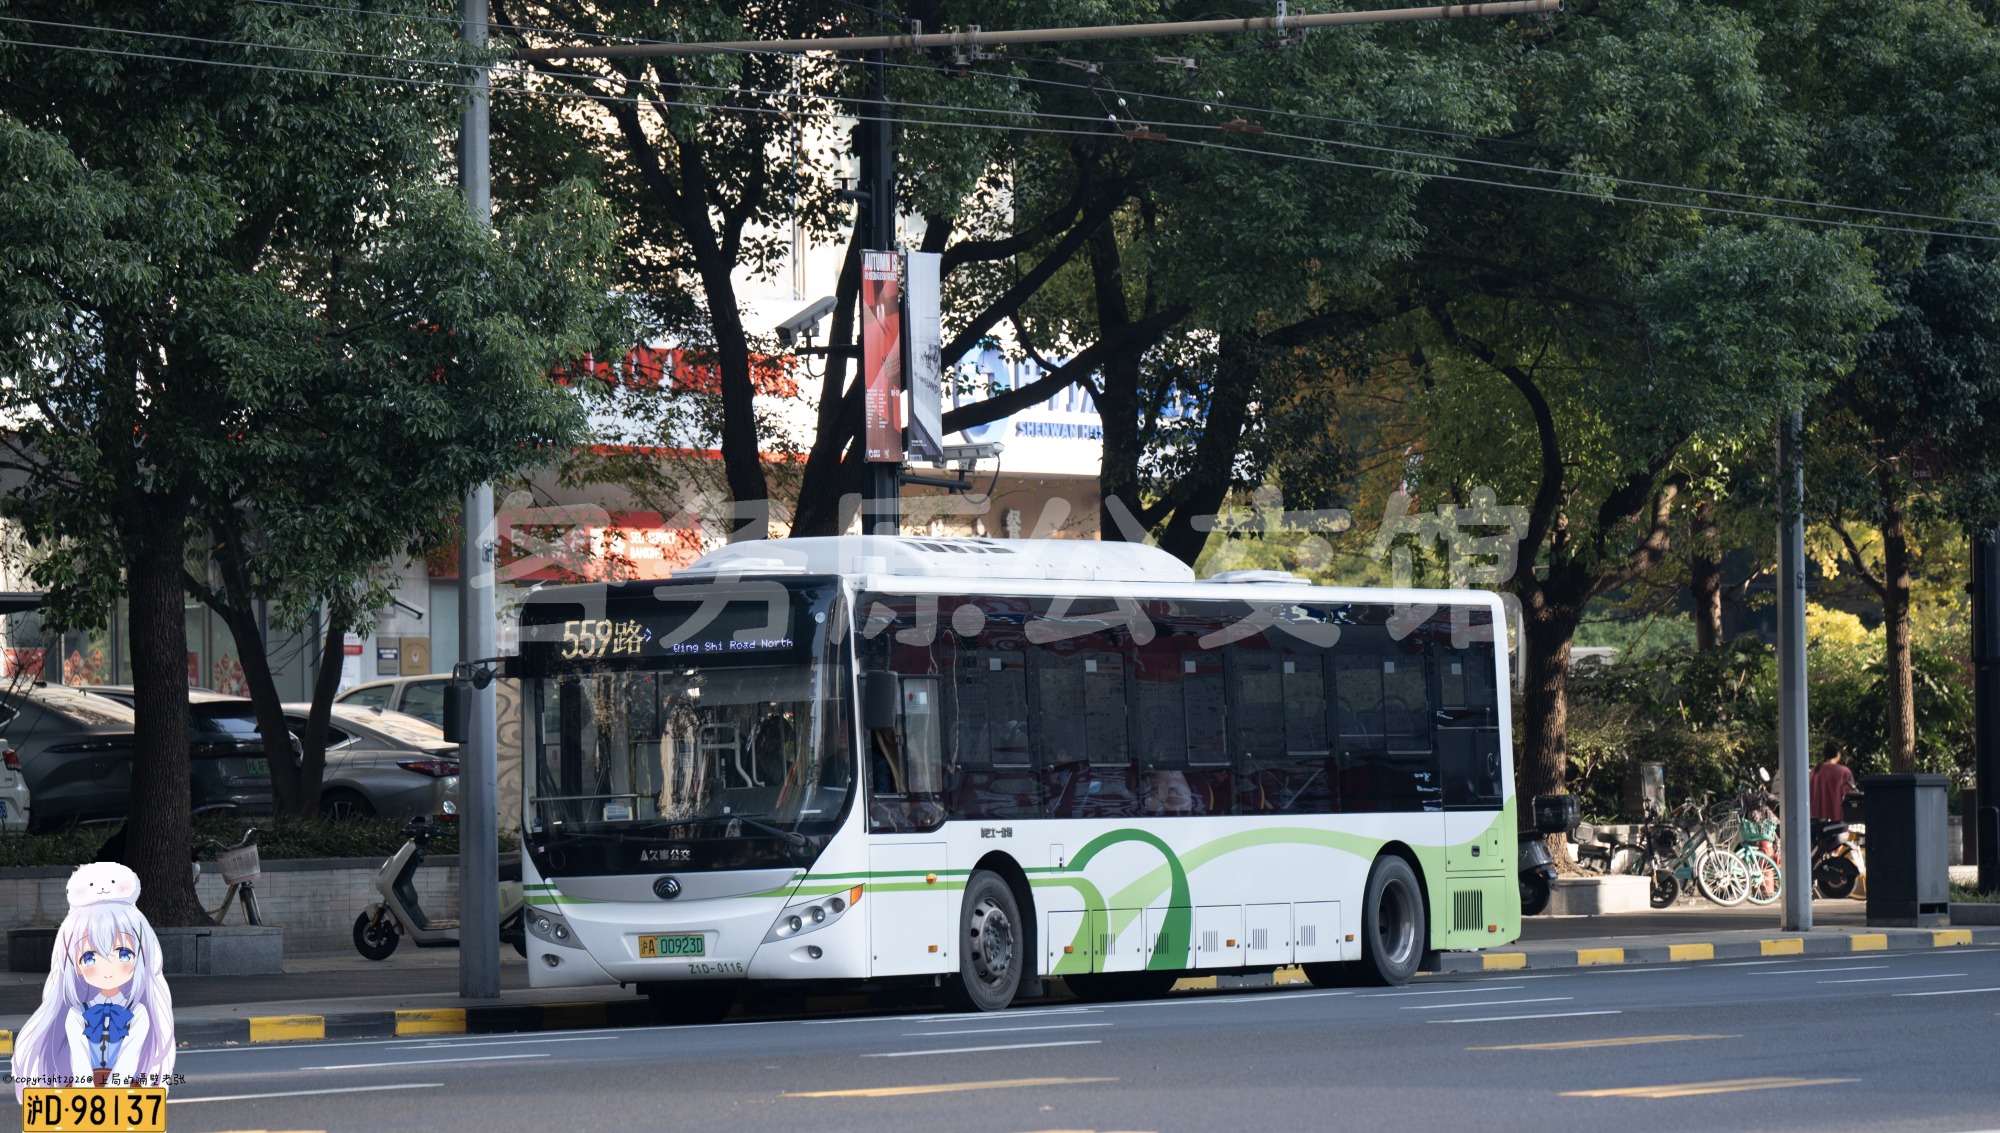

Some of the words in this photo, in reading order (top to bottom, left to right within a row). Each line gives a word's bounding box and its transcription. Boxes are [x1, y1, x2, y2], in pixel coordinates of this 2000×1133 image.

[1016, 421, 1076, 439] SHENWAN
[630, 531, 676, 545] SEL-SERVICE
[562, 619, 644, 660] 559路
[673, 643, 699, 653] Qing
[704, 641, 723, 652] Shi
[729, 639, 756, 650] Road
[761, 638, 793, 649] North
[688, 962, 743, 974] Z1D-0116
